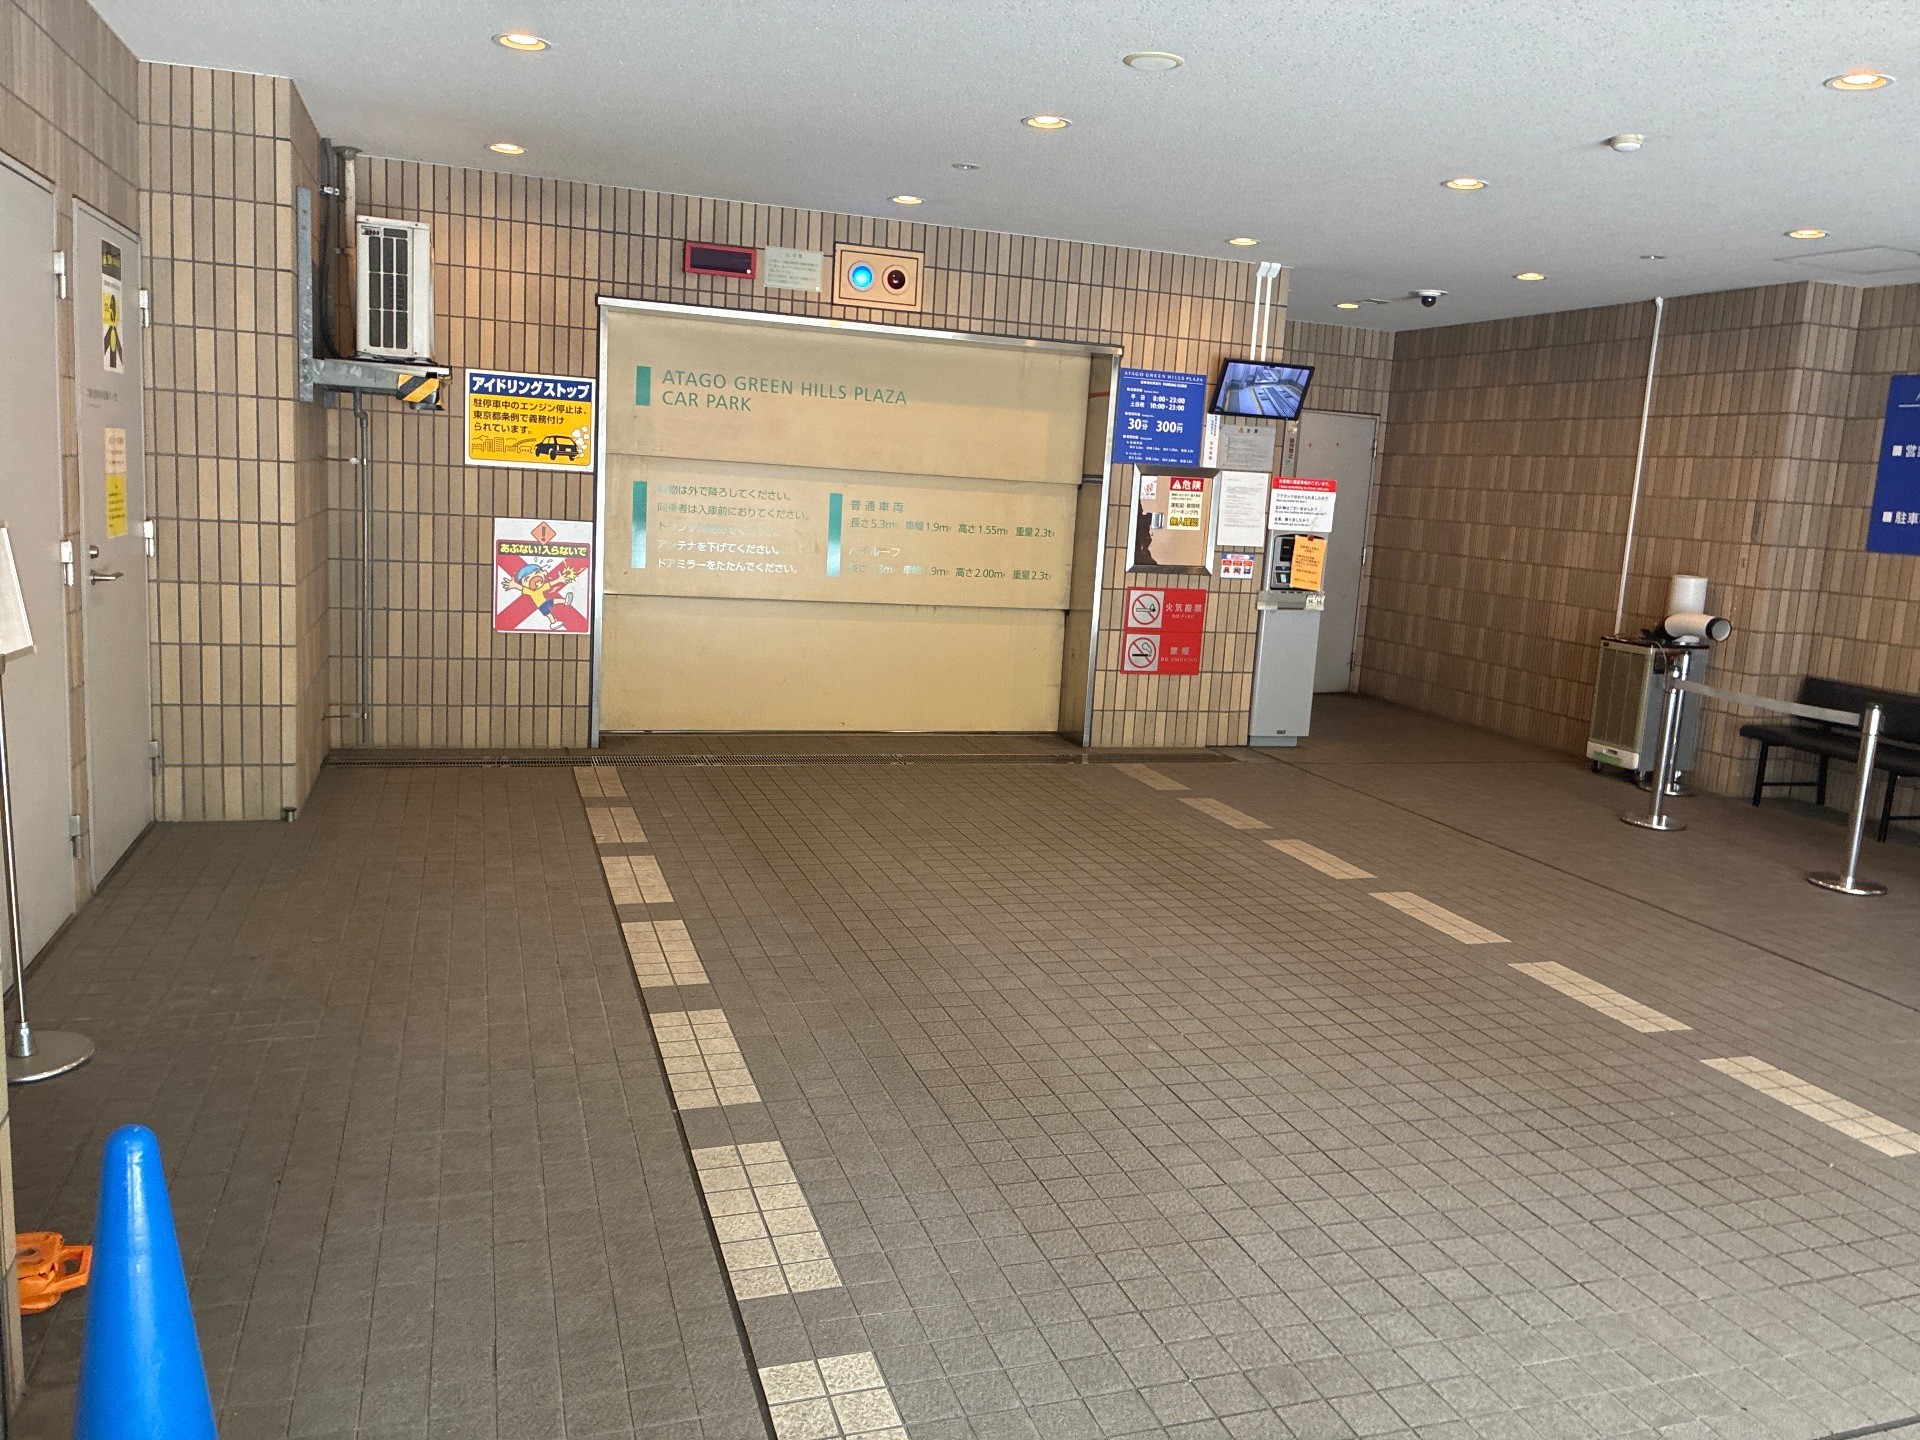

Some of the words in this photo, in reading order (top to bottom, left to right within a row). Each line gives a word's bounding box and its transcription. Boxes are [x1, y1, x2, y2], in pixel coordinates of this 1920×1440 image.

[472, 376, 590, 400] アイドリングストップ
[662, 369, 726, 389] ATAGO
[734, 375, 793, 395] GREEN
[801, 381, 847, 400] HILLS
[854, 386, 907, 405] PLAZA
[473, 397, 587, 415] 駐停車中のエンジン停止は、
[662, 390, 699, 407] CAR
[706, 394, 752, 411] PARK
[473, 410, 565, 425] 東京都条例で義務付け
[473, 422, 532, 435] られています。
[1182, 479, 1202, 490] 危険
[850, 499, 904, 514] 普通車両
[656, 539, 780, 555] アンテナを下げてください。
[656, 557, 798, 574] ドアミラーをたたんでください。
[1165, 602, 1203, 613] 火気厳禁
[1169, 646, 1190, 656] 禁煙
